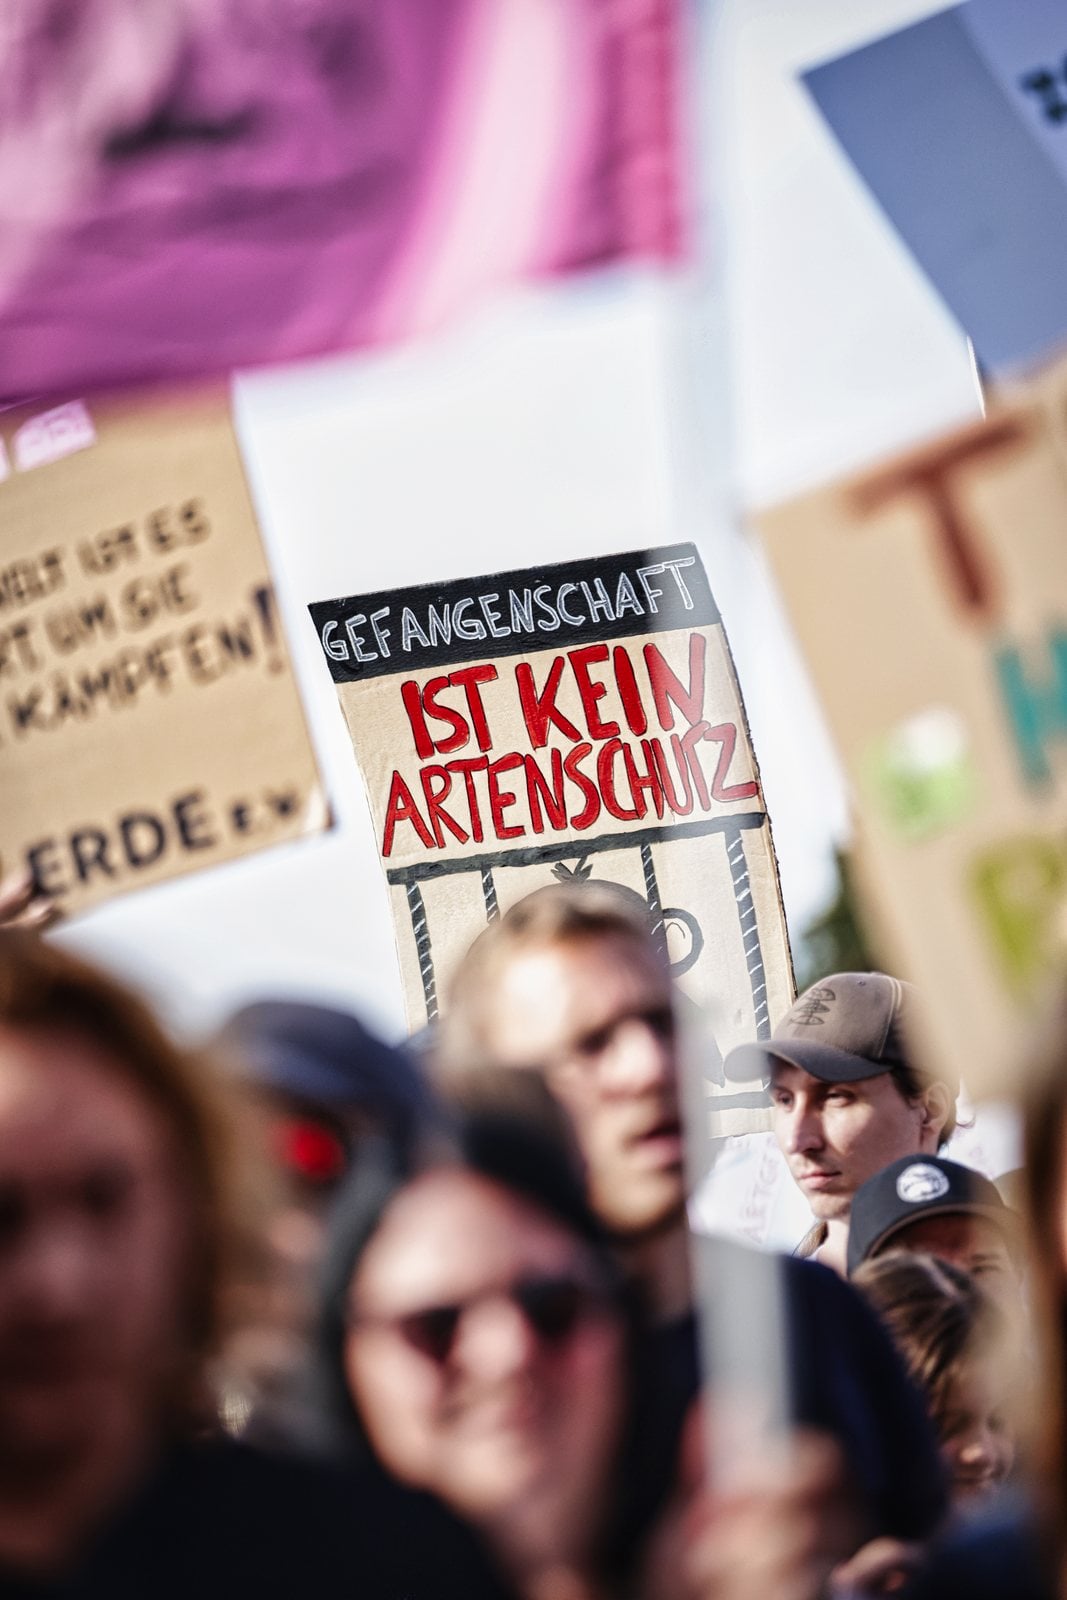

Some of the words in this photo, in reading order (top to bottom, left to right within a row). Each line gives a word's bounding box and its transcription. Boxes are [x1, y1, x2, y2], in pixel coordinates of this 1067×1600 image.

[147, 497, 210, 553] ES
[321, 556, 696, 663] GEFANGENSCHAFT
[400, 663, 499, 760] IST
[515, 632, 707, 749] KEIN
[26, 791, 213, 895] ERDE
[381, 720, 759, 859] ARTENSCHUTZ
